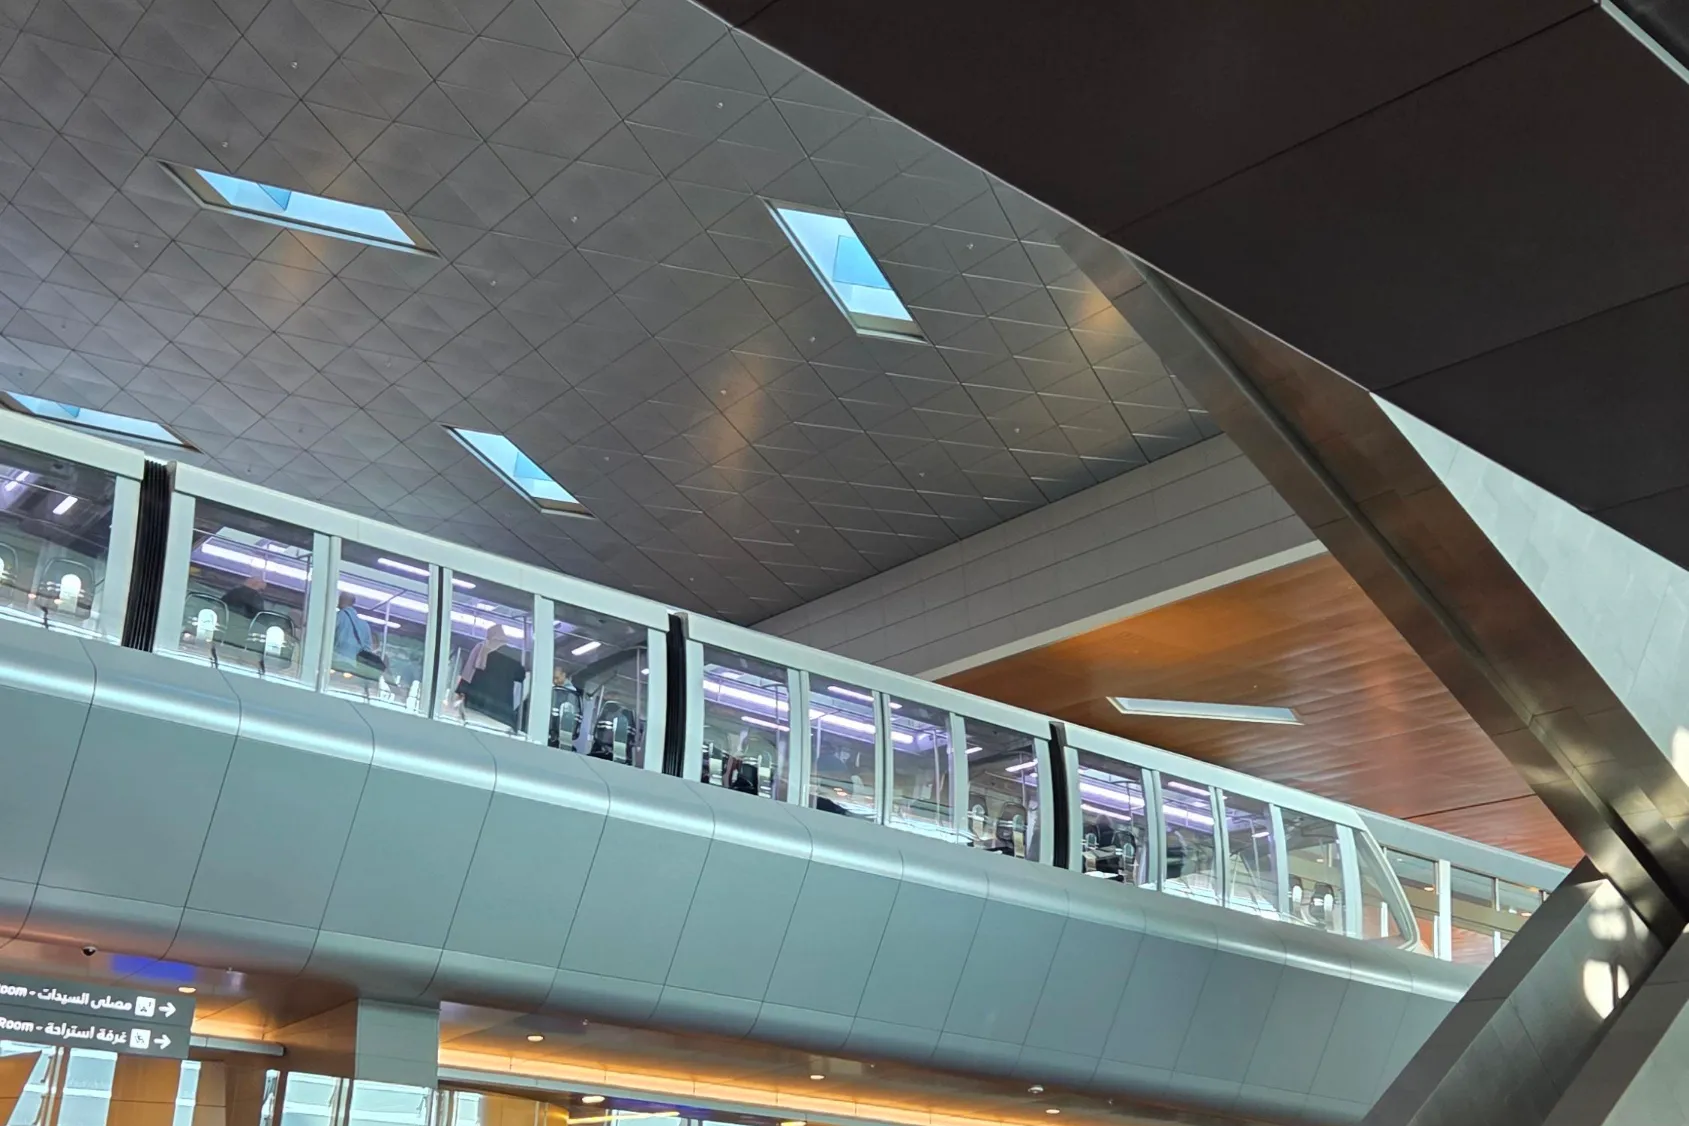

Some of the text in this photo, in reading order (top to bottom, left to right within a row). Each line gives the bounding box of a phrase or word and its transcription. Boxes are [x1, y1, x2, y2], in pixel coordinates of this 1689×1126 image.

[0, 984, 28, 998] oom
[37, 988, 90, 1005] السيدات
[90, 995, 132, 1011] مصلى
[44, 1022, 95, 1039] استراحة
[96, 1028, 127, 1045] غرفة
